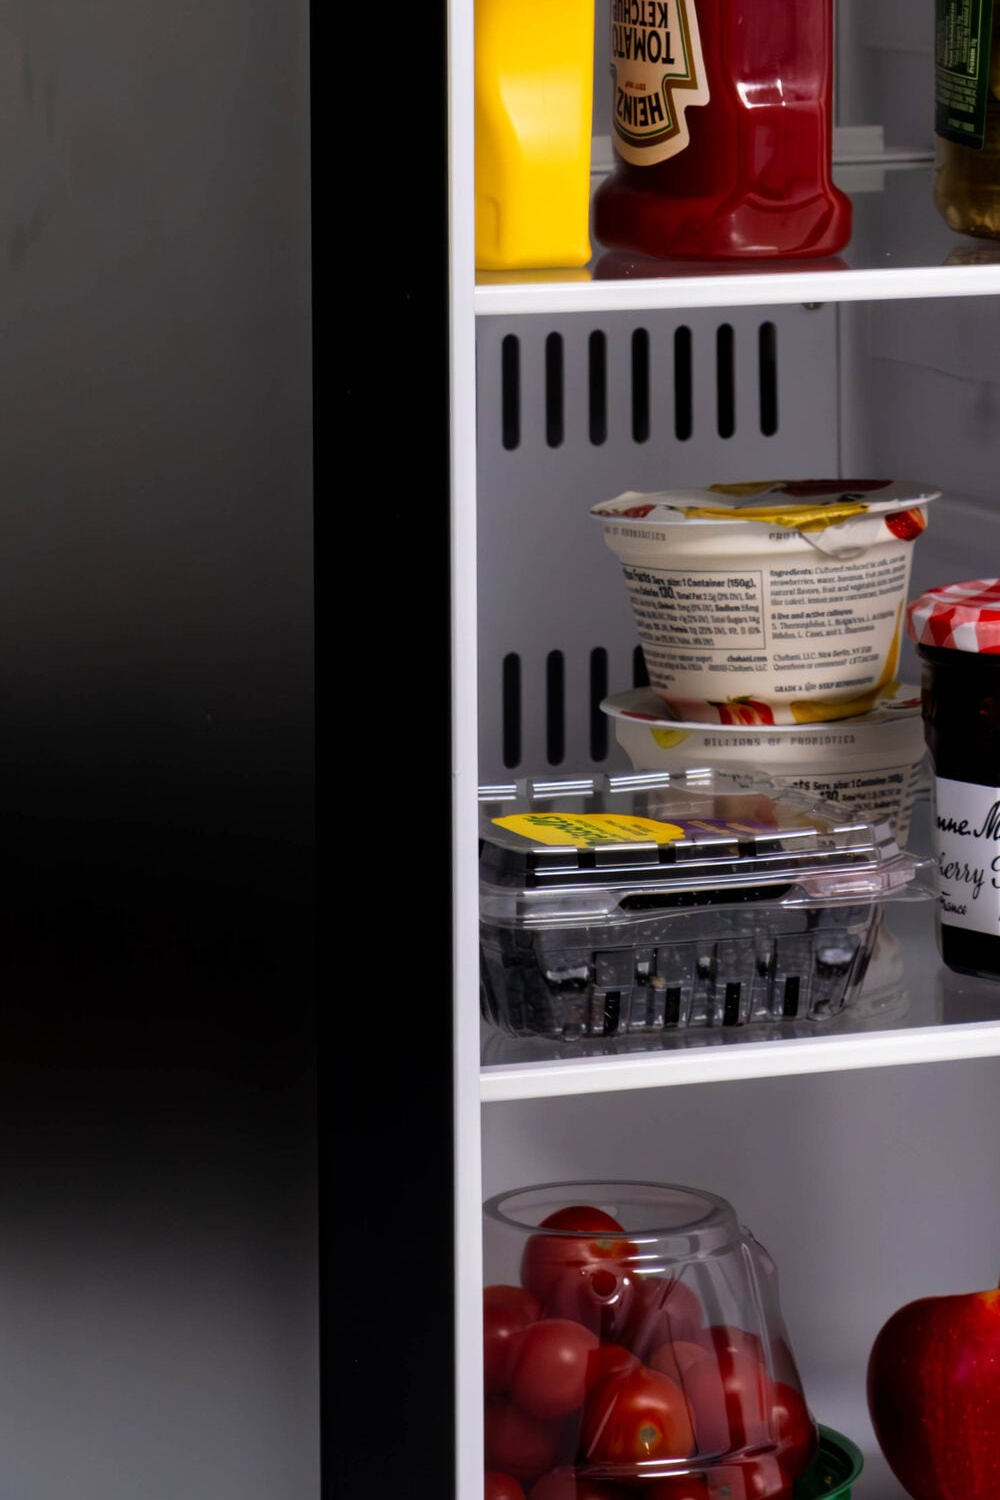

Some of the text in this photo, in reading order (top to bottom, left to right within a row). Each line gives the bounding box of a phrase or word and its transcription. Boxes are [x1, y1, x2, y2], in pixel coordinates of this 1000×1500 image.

[612, 24, 675, 65] TOMATO
[617, 86, 664, 127] HEINZ
[769, 531, 799, 540] PROT
[687, 578, 725, 587] Container
